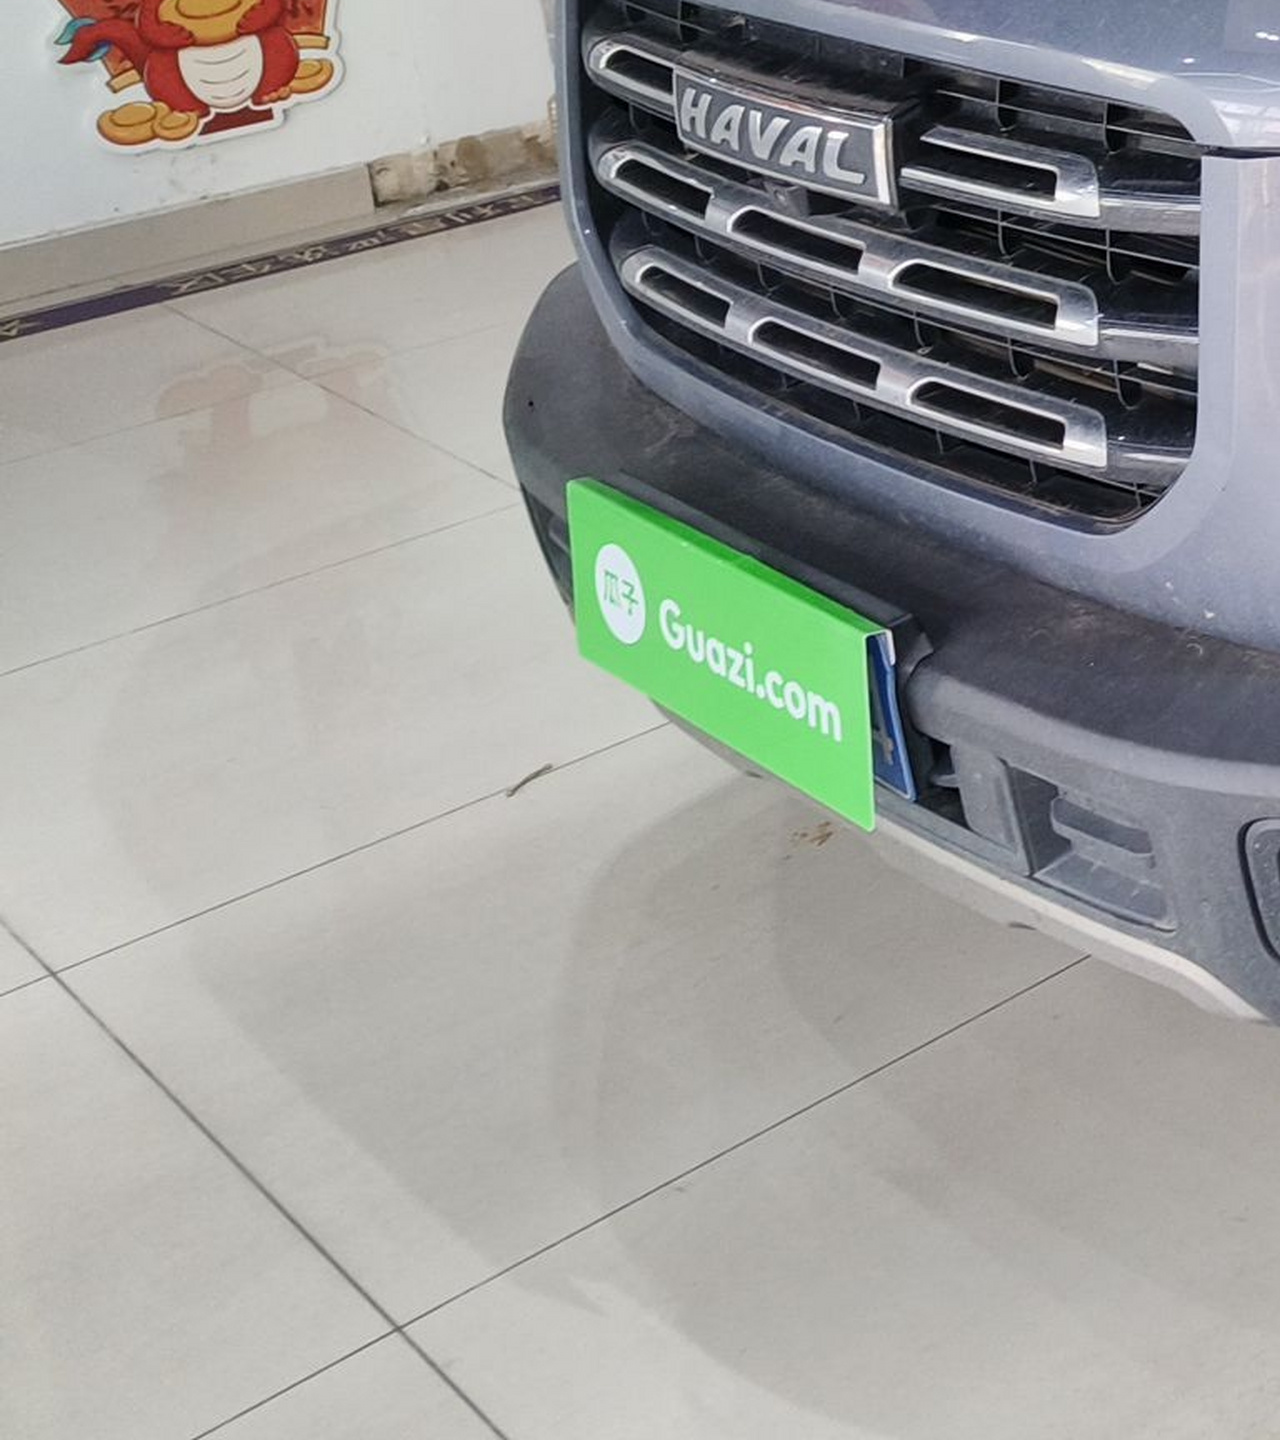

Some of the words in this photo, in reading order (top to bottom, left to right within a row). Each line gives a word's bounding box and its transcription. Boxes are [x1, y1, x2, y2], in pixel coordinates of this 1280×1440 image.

[680, 87, 866, 185] HAVAL
[604, 569, 639, 616] 瓜子
[659, 598, 842, 742] Guazi.com
